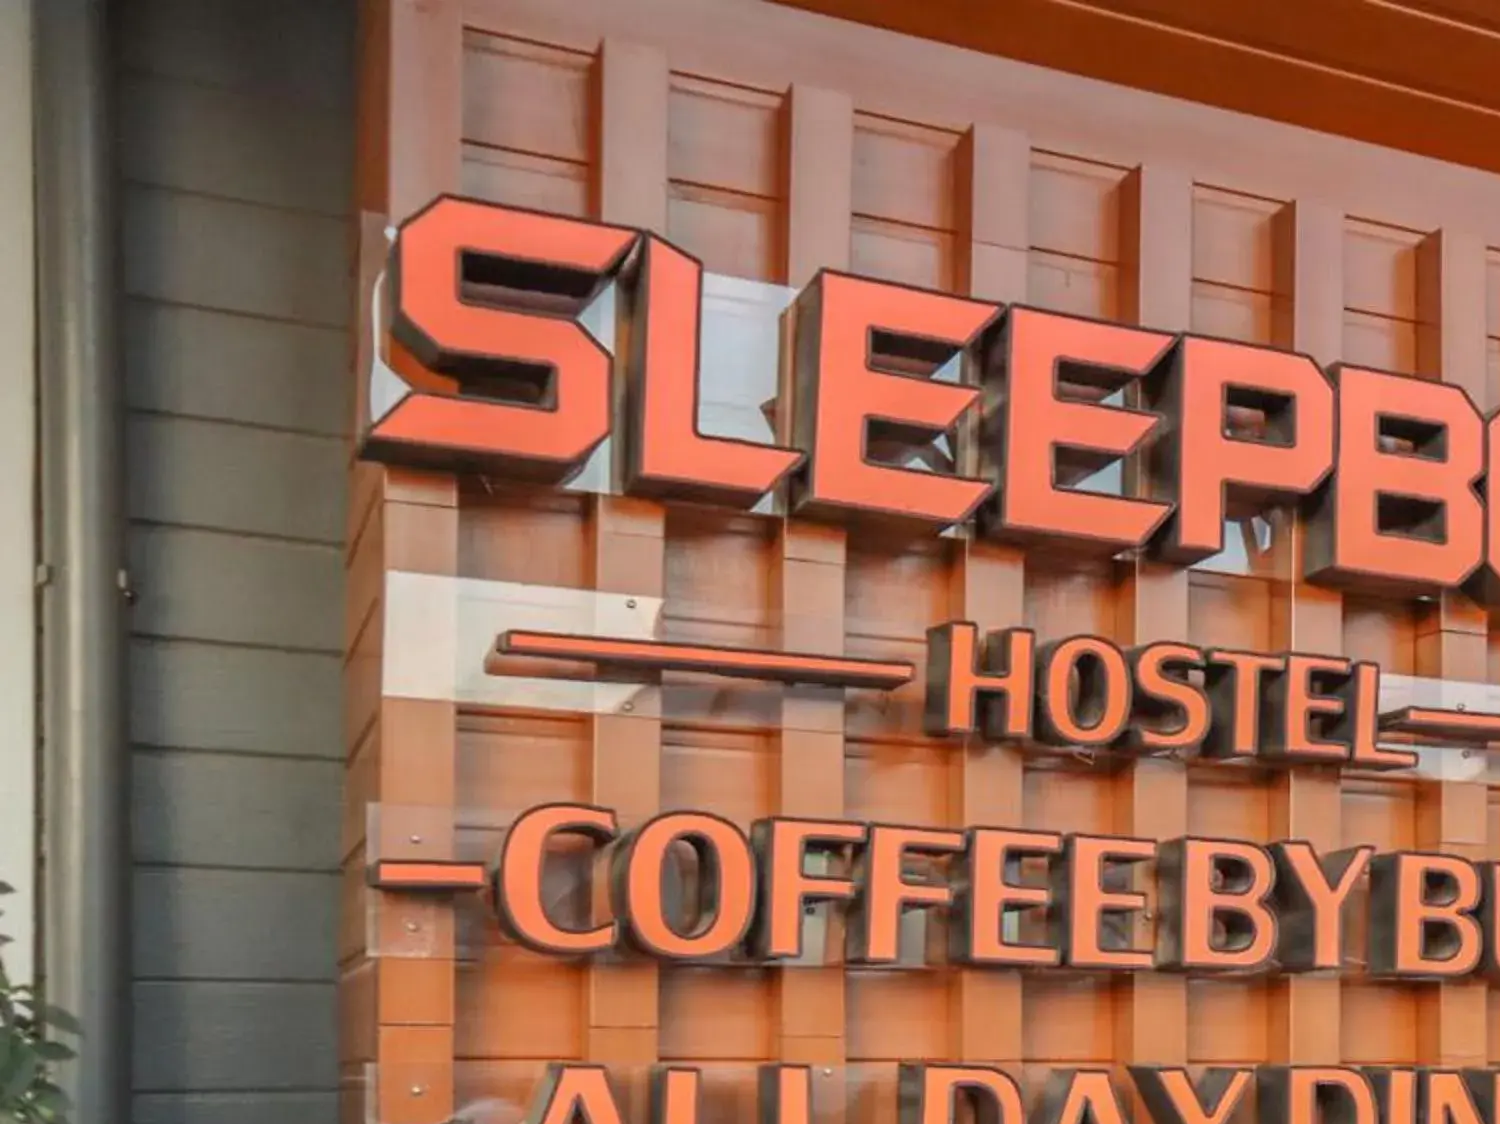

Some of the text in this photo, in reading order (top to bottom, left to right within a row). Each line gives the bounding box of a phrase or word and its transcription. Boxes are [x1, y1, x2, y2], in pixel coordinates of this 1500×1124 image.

[926, 621, 1419, 769] HOSTEL
[497, 802, 1157, 967] COFFEE
[1167, 836, 1375, 971] BY
